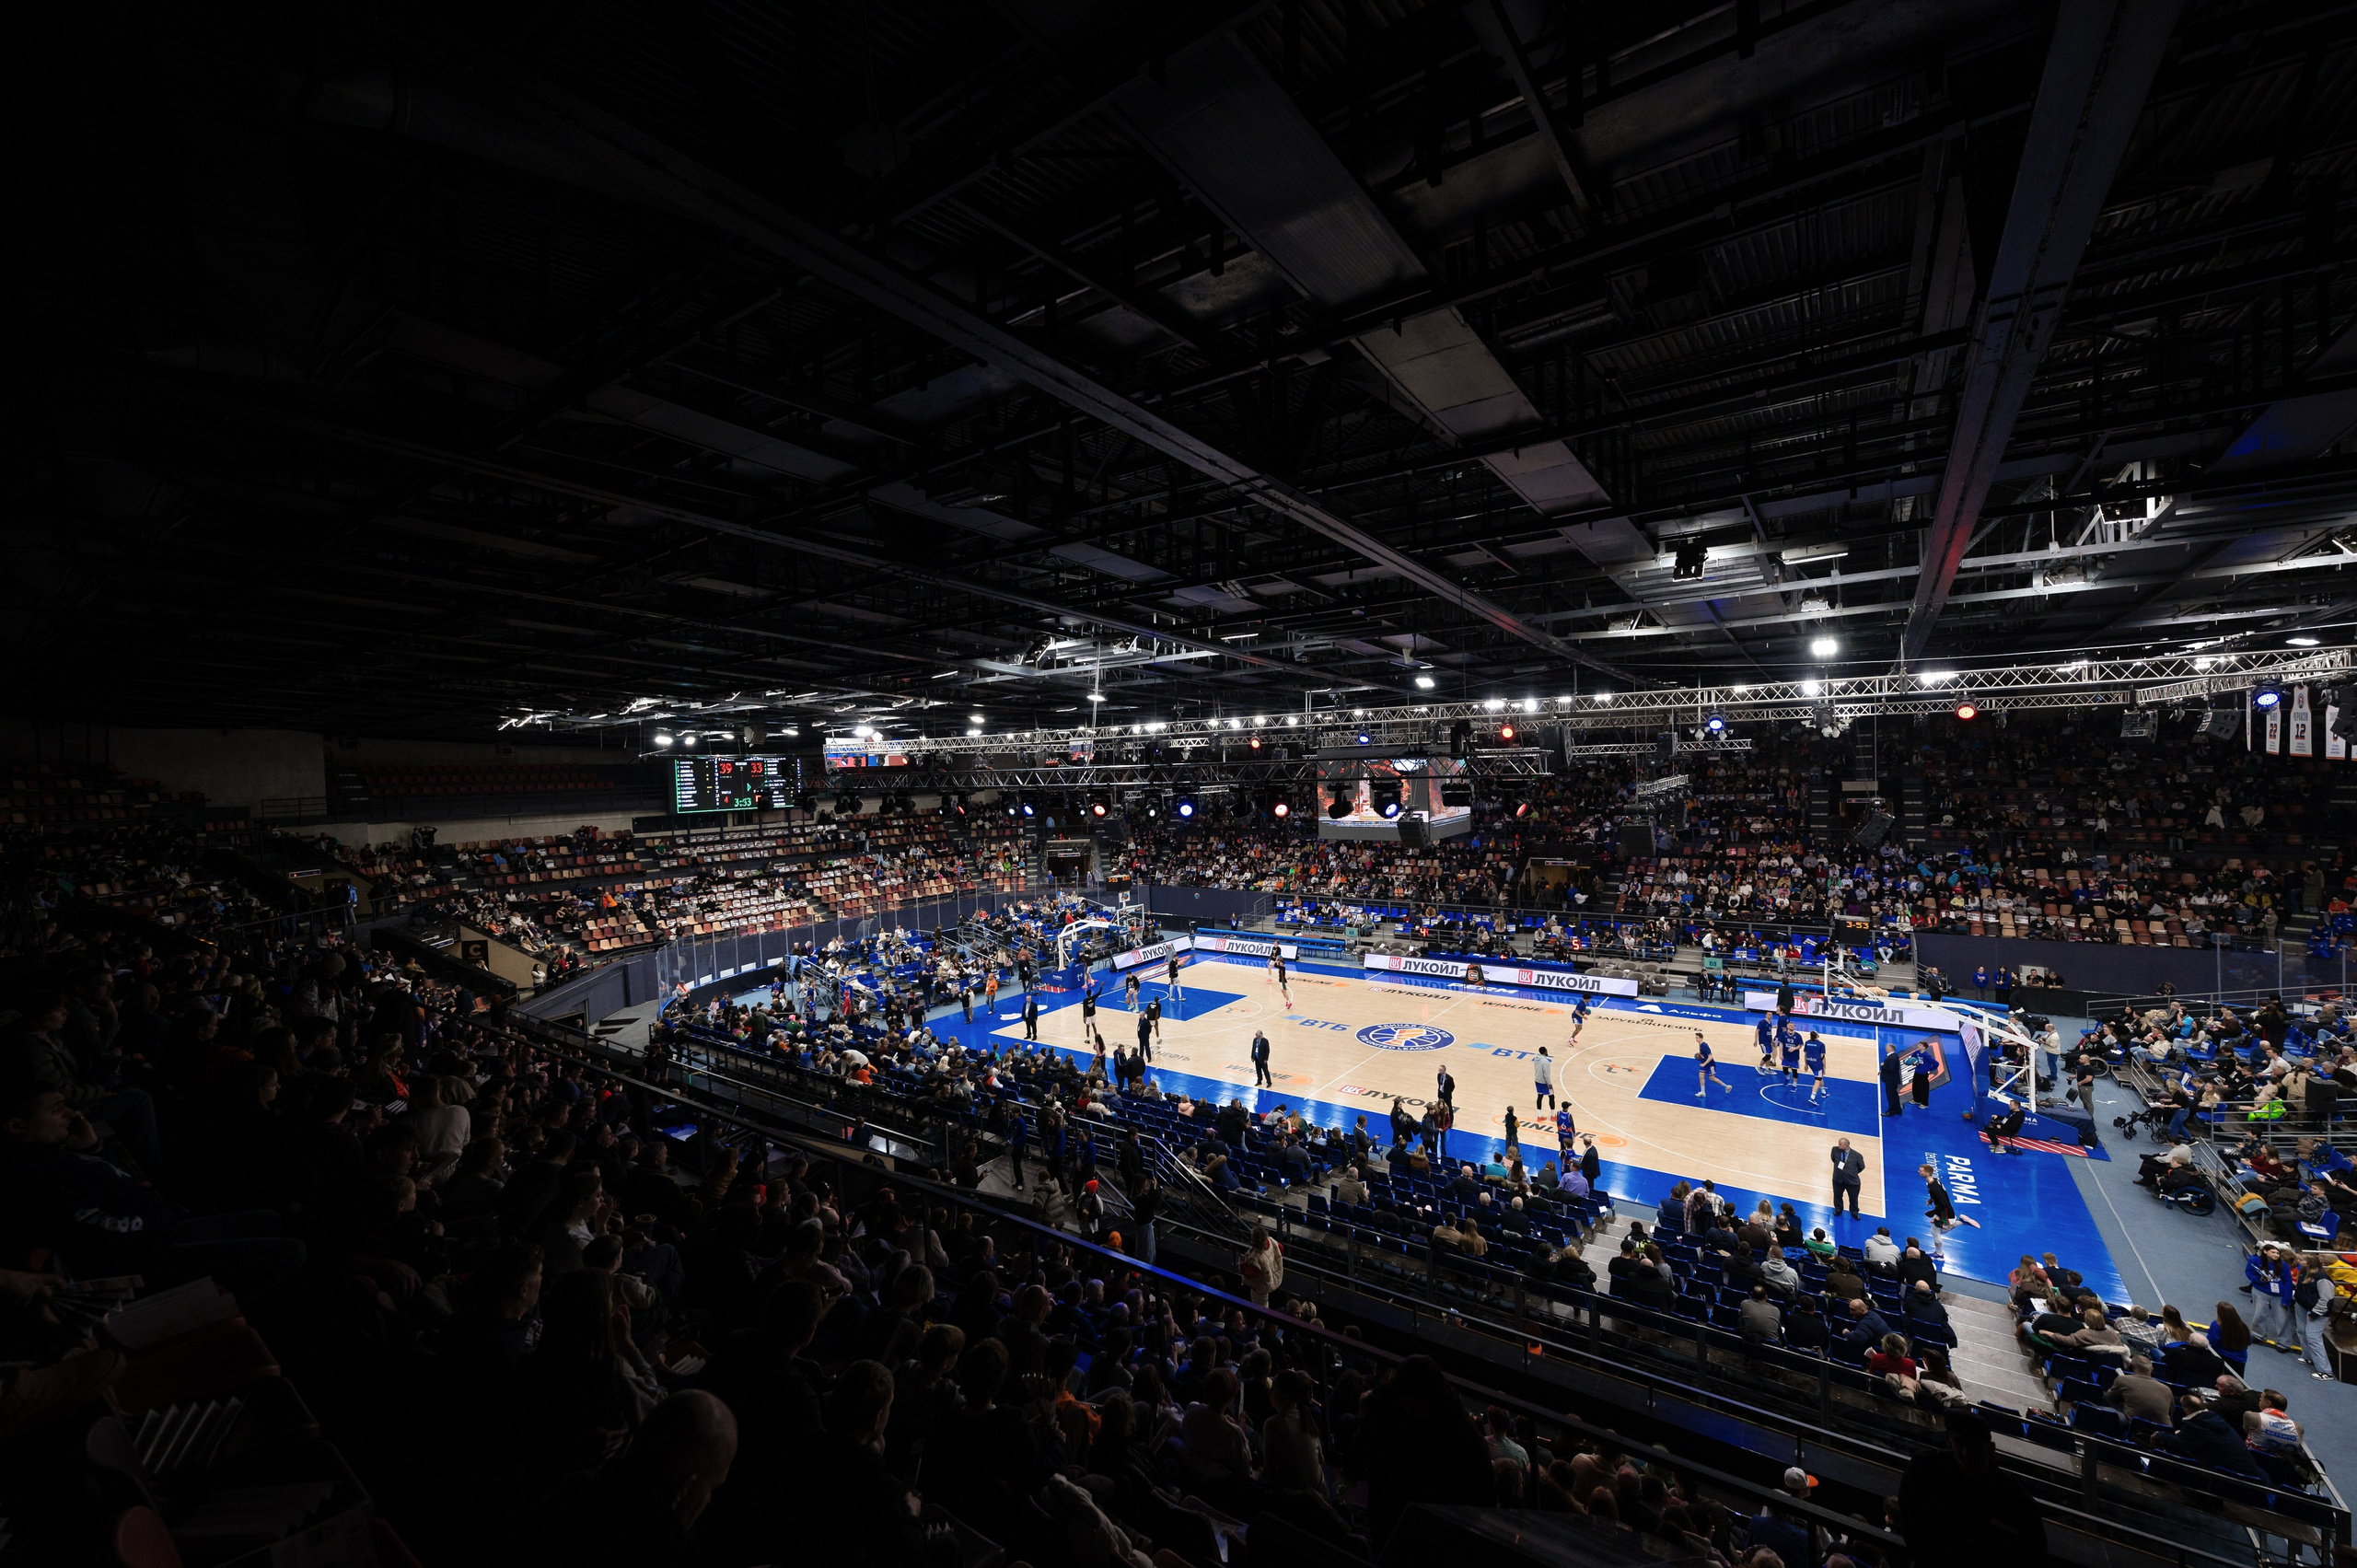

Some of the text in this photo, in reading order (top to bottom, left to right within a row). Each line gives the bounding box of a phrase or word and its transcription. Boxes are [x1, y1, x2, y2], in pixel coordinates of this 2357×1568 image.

[2269, 724, 2277, 739] 22
[2294, 724, 2305, 739] 12
[720, 762, 733, 773] 39
[751, 762, 762, 773] 33
[1226, 943, 1271, 955] ЛУКОЙЛ
[1403, 960, 1458, 975] ЛУКОЙЛ
[1535, 974, 1600, 991] ЛУКОЙЛ
[1482, 1001, 1545, 1012] WINLINE
[1299, 1018, 1351, 1031] ВТБ
[1945, 1155, 1981, 1204] PARMA
